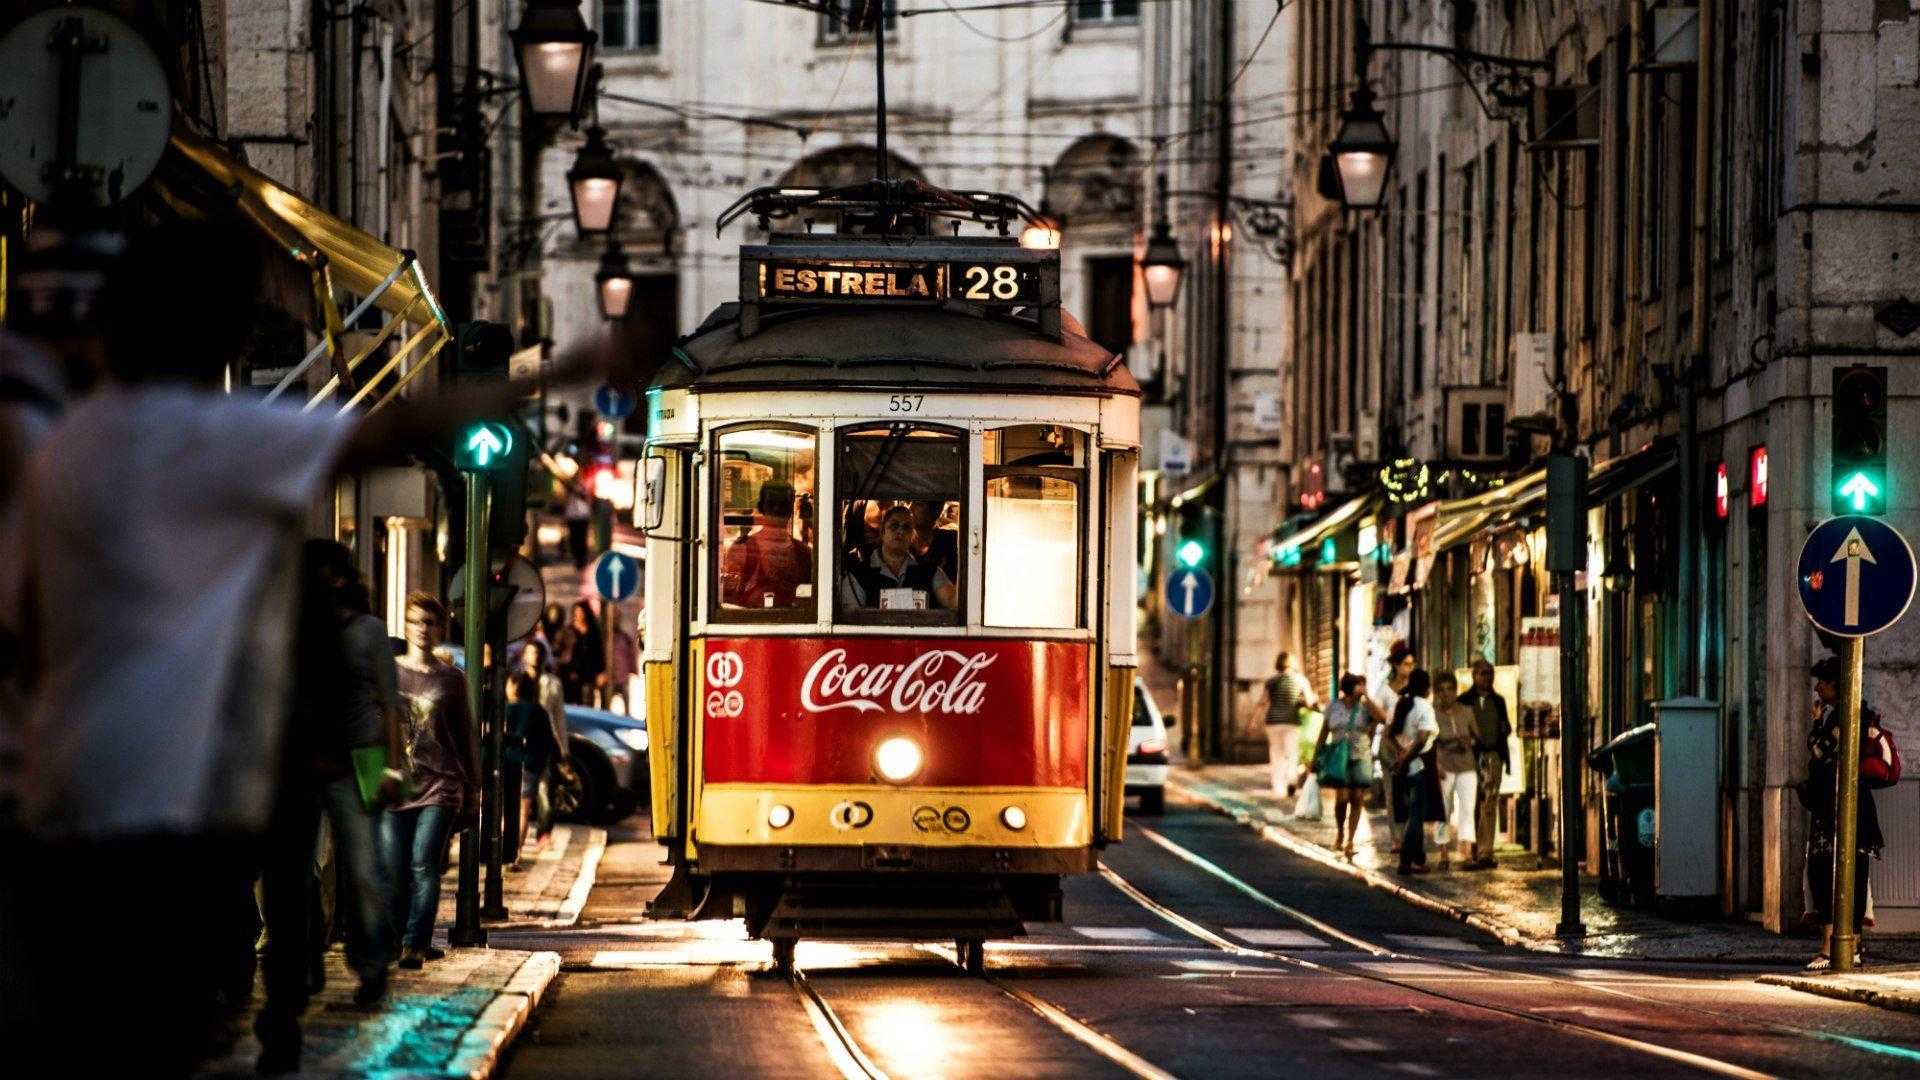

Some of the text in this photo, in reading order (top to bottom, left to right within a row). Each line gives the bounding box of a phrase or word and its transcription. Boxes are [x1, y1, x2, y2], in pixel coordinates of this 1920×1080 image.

[774, 266, 1019, 300] ESTRELA 28
[890, 395, 924, 411] 557
[801, 648, 998, 714] Coca-Cola
